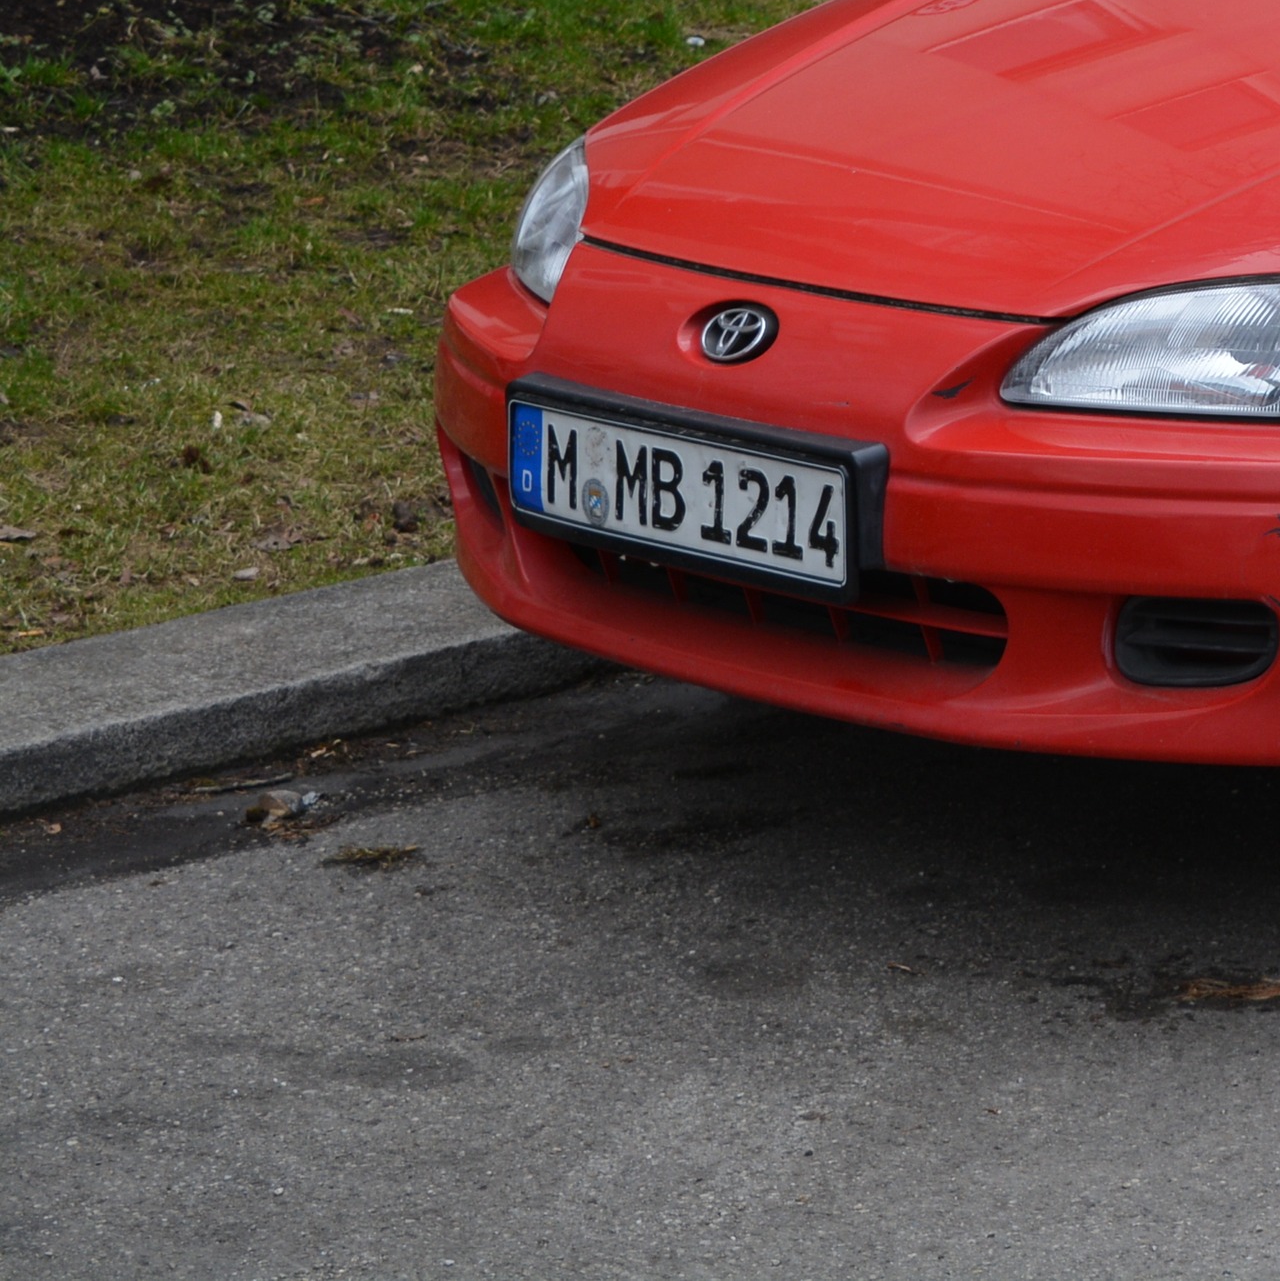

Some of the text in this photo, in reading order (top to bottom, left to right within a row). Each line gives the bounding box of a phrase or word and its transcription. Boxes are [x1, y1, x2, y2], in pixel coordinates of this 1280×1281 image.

[521, 469, 532, 492] D
[547, 423, 578, 510] M
[615, 439, 687, 532] MB
[700, 459, 840, 568] 1214
